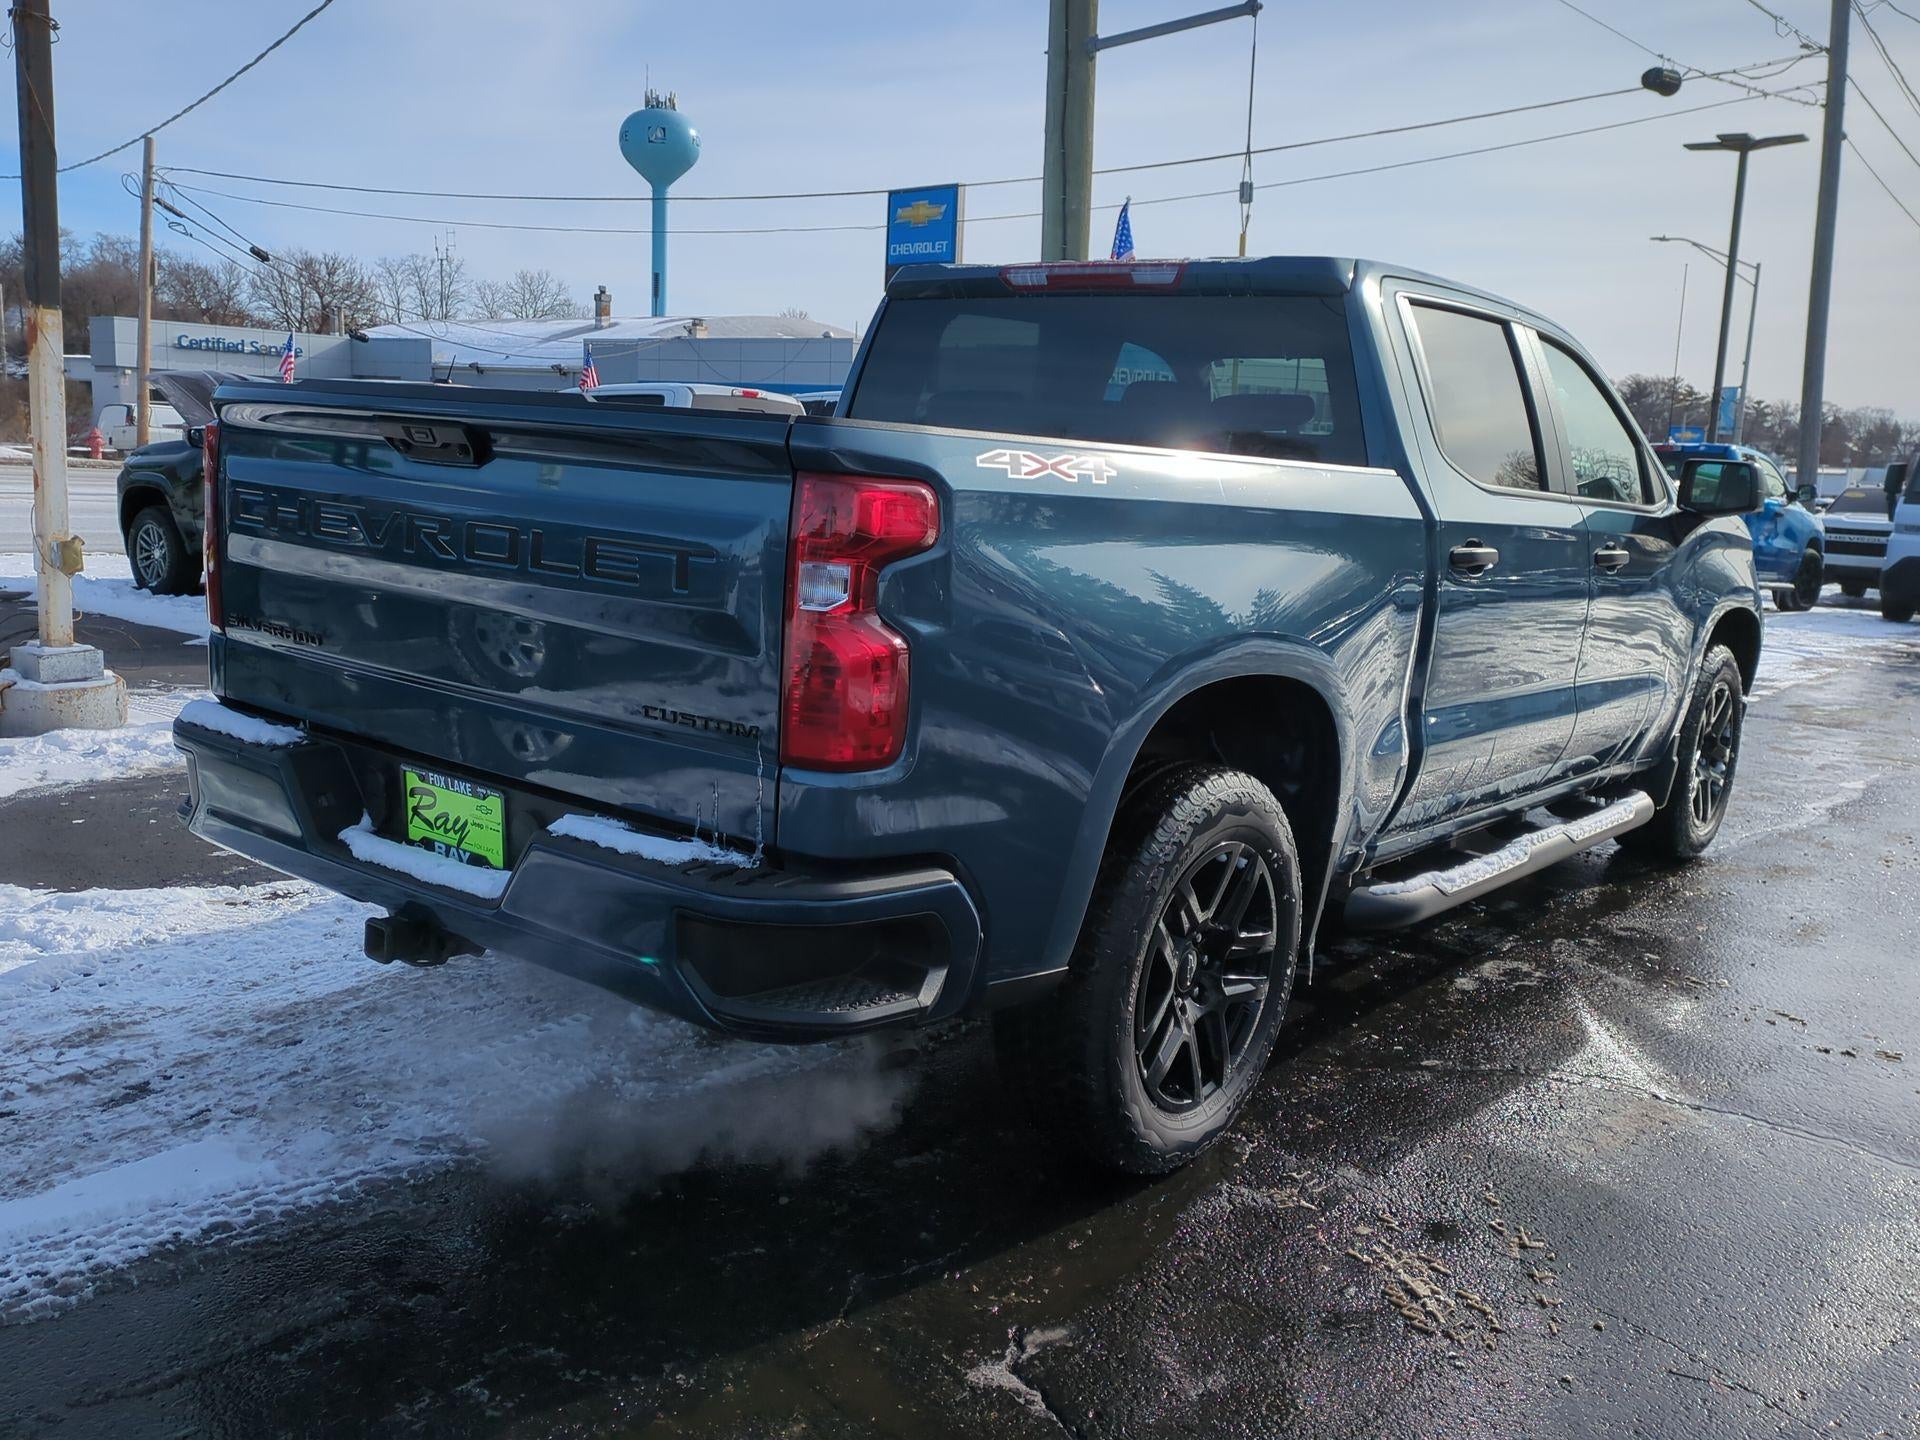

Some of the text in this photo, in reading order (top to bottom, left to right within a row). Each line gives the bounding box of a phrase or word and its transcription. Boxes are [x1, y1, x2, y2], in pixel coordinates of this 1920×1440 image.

[890, 240, 949, 256] CHEVROLET
[177, 334, 304, 358] Certified Servie
[233, 487, 717, 594] CHEVROLET
[641, 704, 761, 739] CUSTOM
[428, 772, 446, 789] FOX
[448, 778, 473, 796] LAKE
[408, 786, 471, 849] Ray
